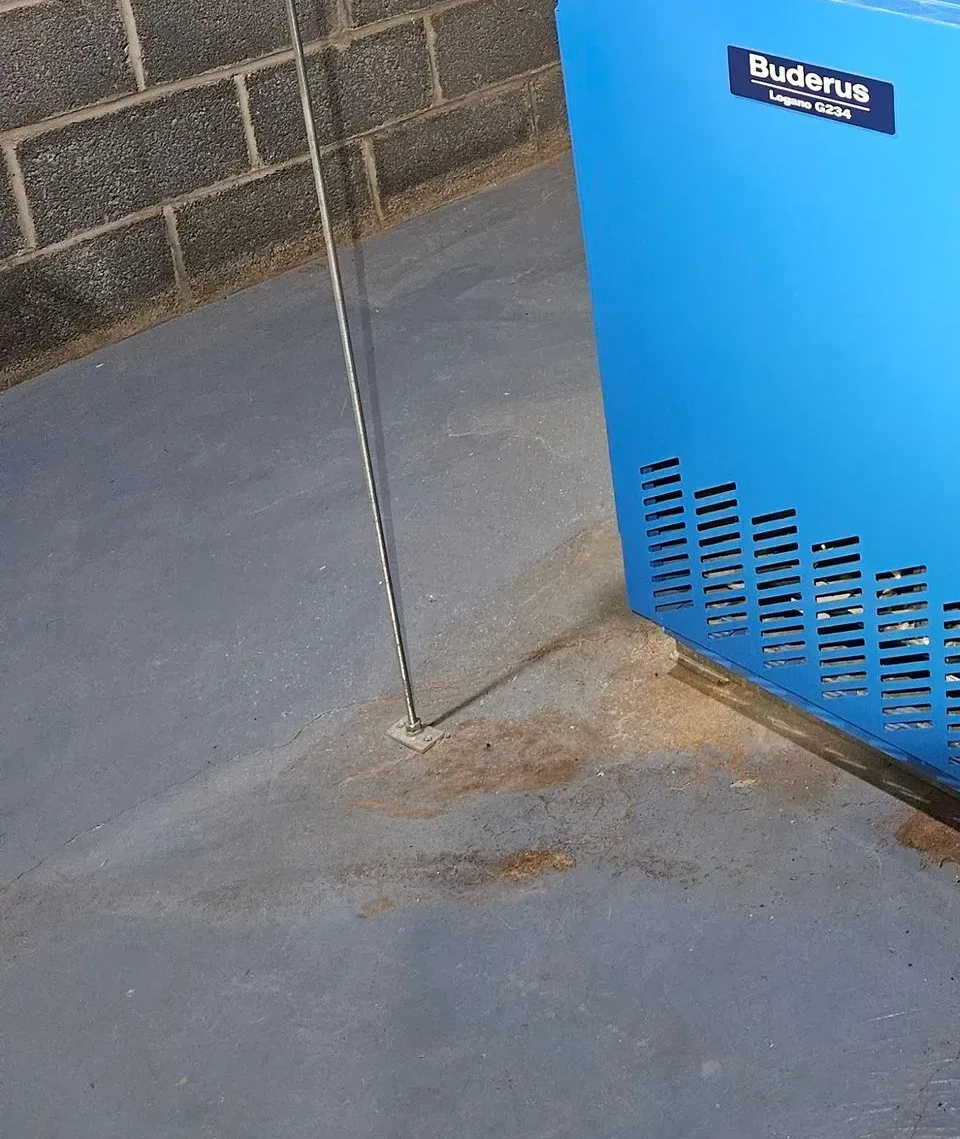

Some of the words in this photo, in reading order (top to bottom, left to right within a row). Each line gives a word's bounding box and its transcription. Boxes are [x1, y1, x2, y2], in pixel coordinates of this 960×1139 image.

[749, 53, 871, 104] Buderus
[768, 89, 813, 111] Logano
[814, 101, 853, 120] G234
